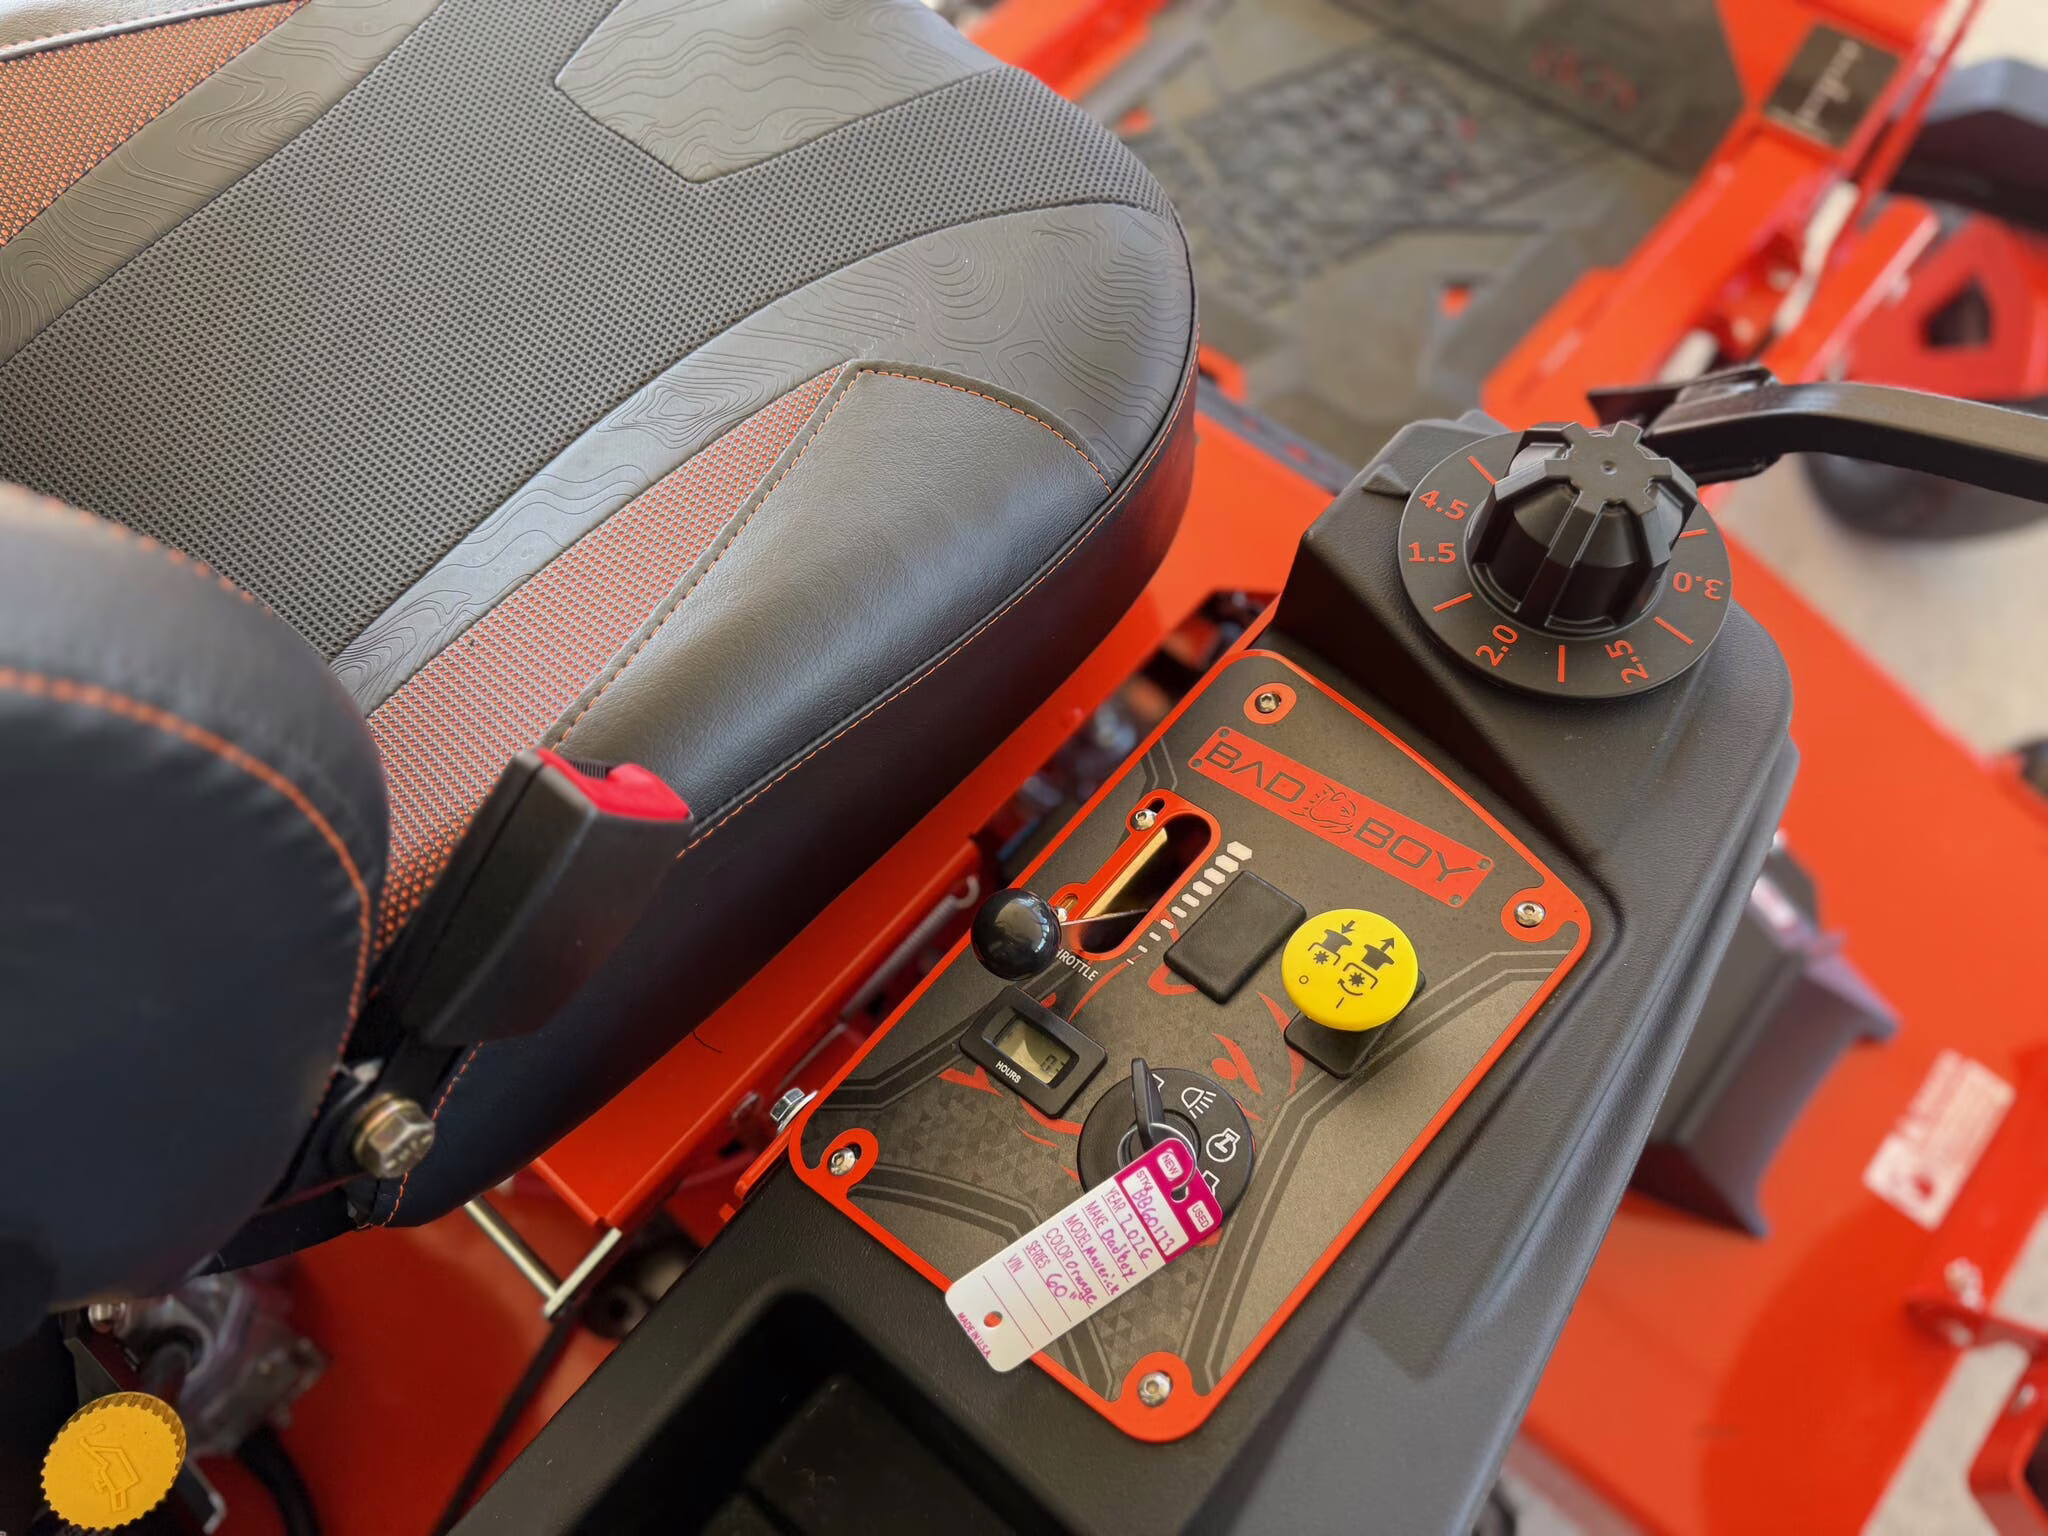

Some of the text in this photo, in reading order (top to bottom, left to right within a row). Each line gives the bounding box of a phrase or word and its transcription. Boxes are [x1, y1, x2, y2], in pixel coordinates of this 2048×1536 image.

[1418, 490, 1470, 520] 4.5
[1407, 542, 1456, 563] 1.5
[1672, 572, 1724, 600] 3.0
[1475, 625, 1519, 667] 2.0
[1604, 640, 1649, 684] 2.5
[1204, 741, 1474, 882] BAD BOY
[1055, 948, 1099, 982] HROTTLE
[995, 1060, 1022, 1084] HOURS
[1162, 1154, 1179, 1175] NEW
[1085, 1200, 1109, 1229] MAKE
[1105, 1187, 1153, 1260] YEAR 2026
[1192, 1204, 1210, 1229] USED
[1046, 1228, 1074, 1262] COLOR
[1065, 1213, 1092, 1248] MODEL
[1007, 1253, 1024, 1273] VIN
[1025, 1240, 1050, 1269] SERIES
[958, 1312, 975, 1333] MADE
[971, 1331, 980, 1341] IN
